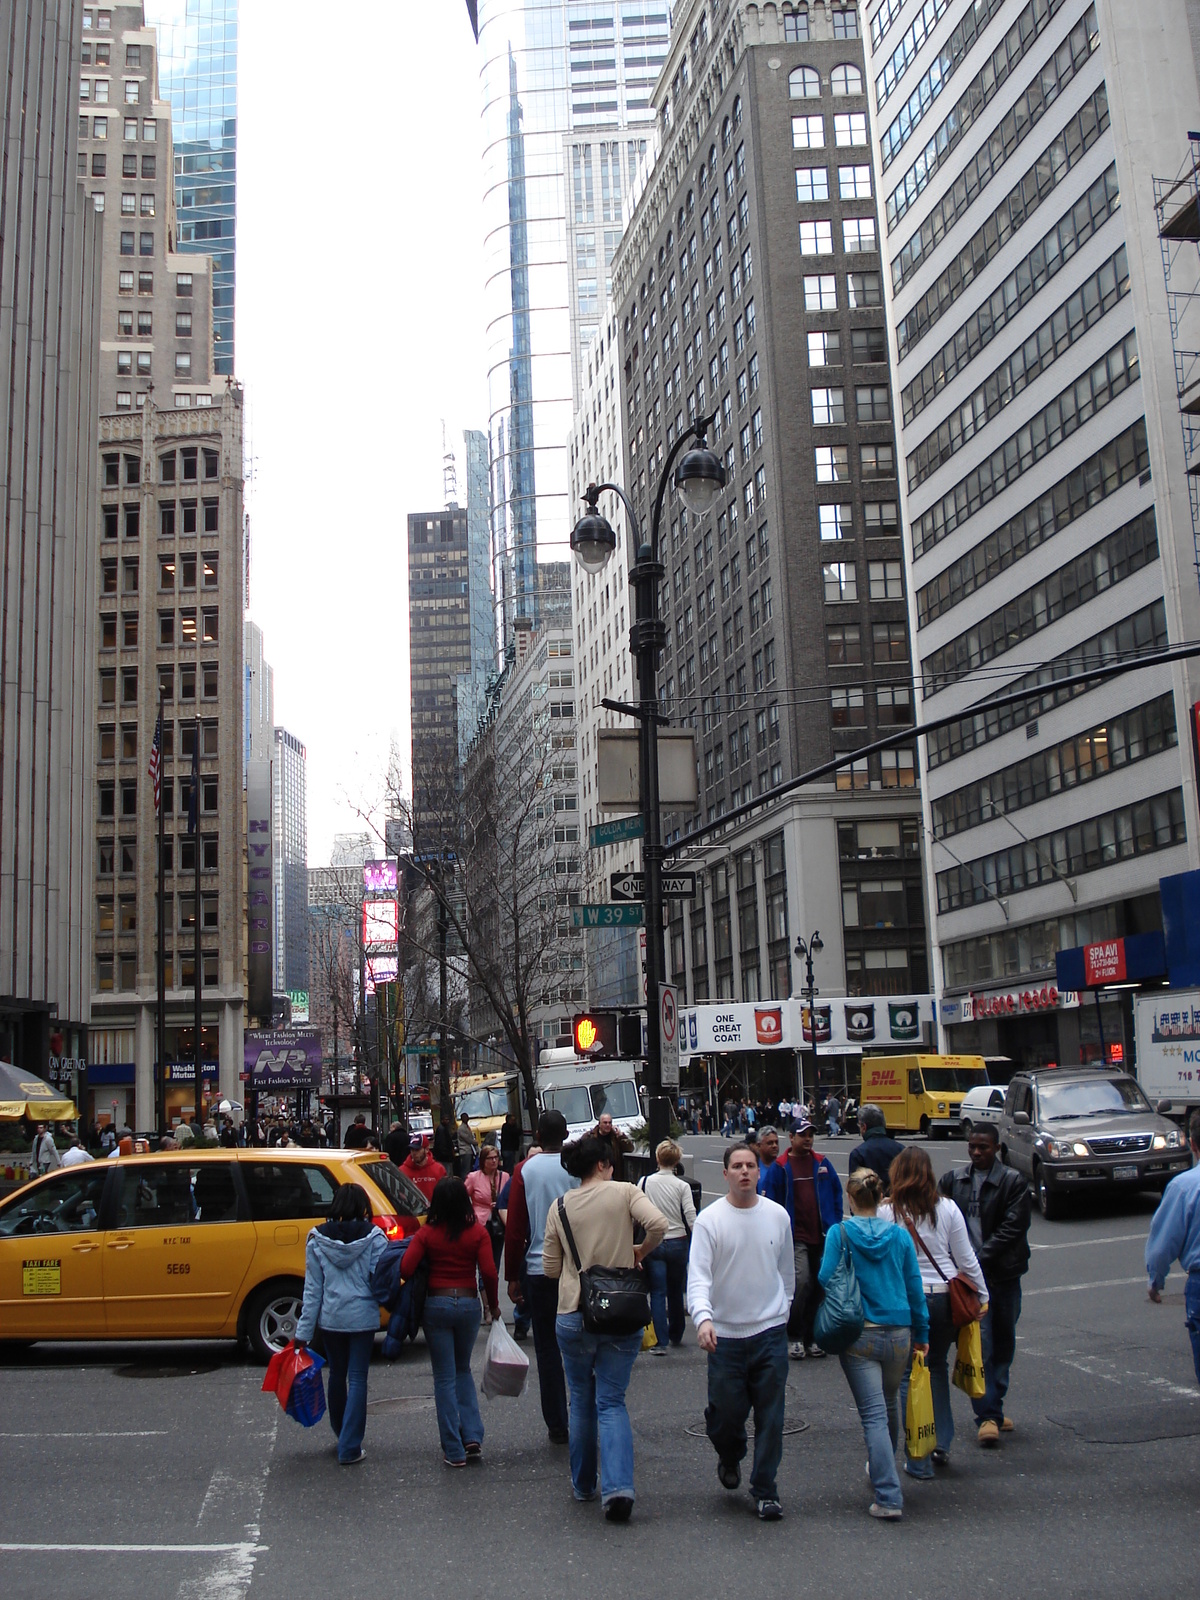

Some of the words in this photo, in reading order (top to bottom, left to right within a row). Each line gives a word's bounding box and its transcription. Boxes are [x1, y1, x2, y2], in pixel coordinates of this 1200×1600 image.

[600, 822, 621, 836] GOLDA
[625, 819, 641, 830] MEIR
[622, 880, 645, 892] ONE
[662, 880, 686, 891] WAY
[588, 908, 599, 924] W
[604, 908, 623, 924] 39
[629, 907, 640, 916] ST
[1090, 946, 1104, 960] SPA
[977, 991, 1014, 1016] duane
[1019, 982, 1058, 1010] reade
[715, 1014, 734, 1023] ONE
[712, 1023, 742, 1033] GREAT
[714, 1033, 742, 1043] COAT!
[172, 1063, 216, 1073] Washiton
[172, 1071, 196, 1079] Mutua
[870, 1070, 900, 1087] DHL
[1178, 1071, 1192, 1081] 718
[180, 1236, 191, 1244] TAXI
[43, 1259, 58, 1267] FARE
[166, 1263, 191, 1275] 5E69
